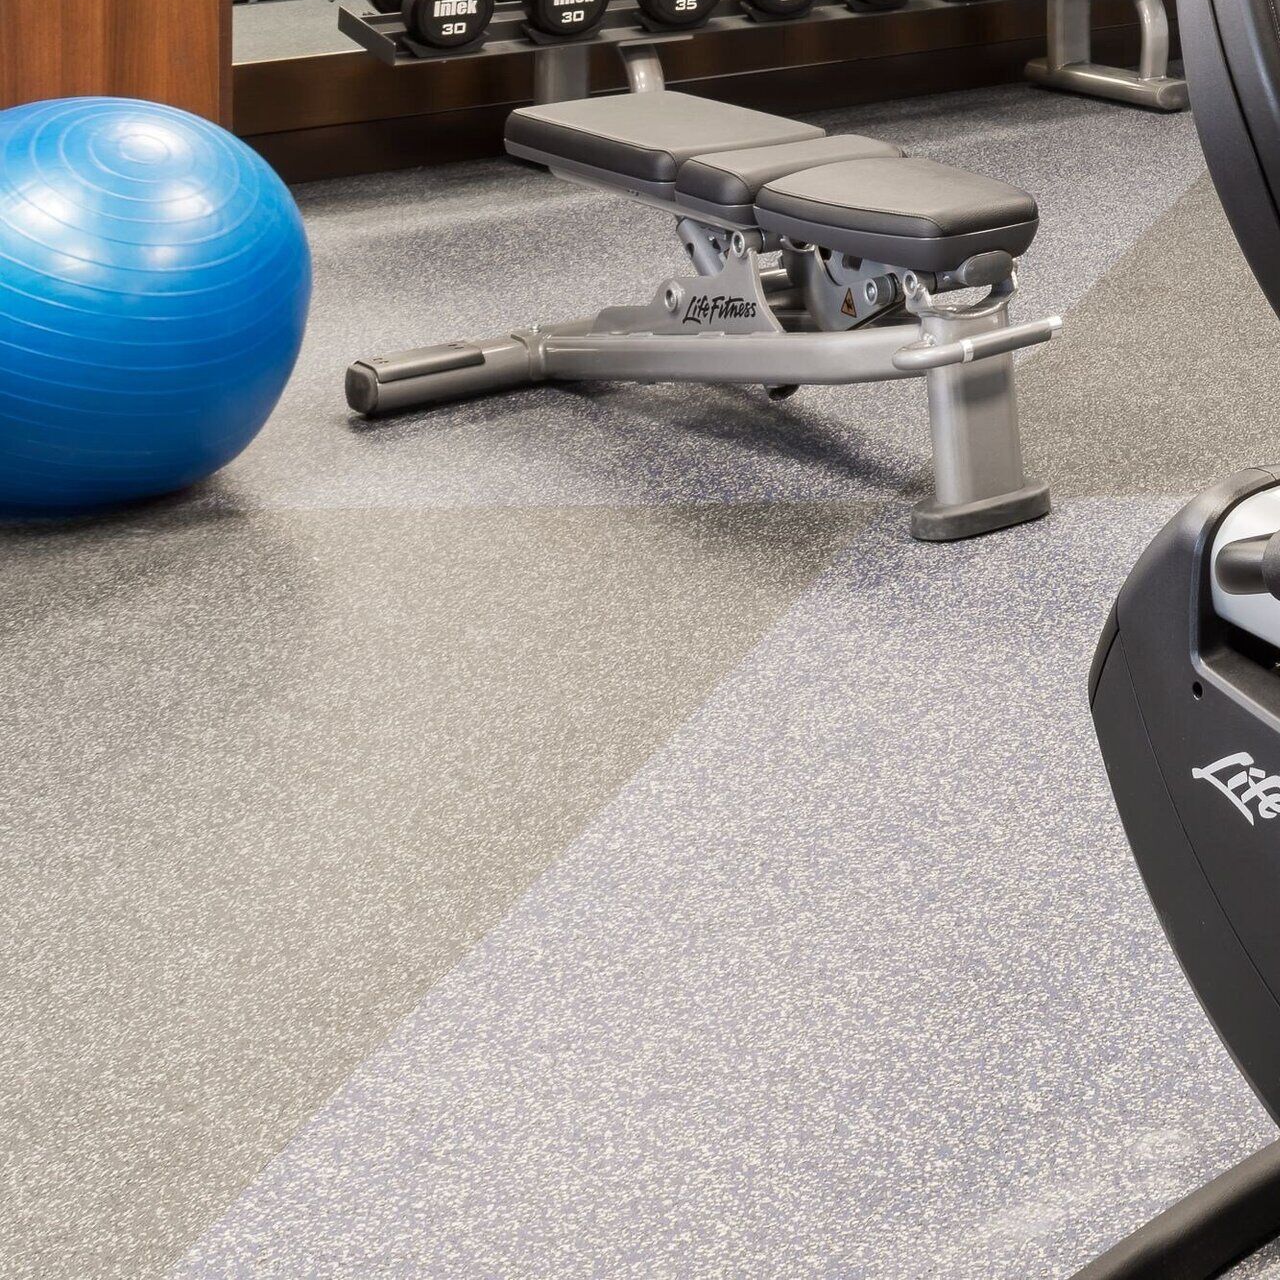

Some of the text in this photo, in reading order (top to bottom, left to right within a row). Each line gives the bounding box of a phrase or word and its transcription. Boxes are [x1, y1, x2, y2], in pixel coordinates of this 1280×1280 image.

[675, 0, 698, 11] 35
[561, 10, 584, 23] 30
[441, 22, 467, 35] 30
[682, 295, 757, 325] Life Fitness
